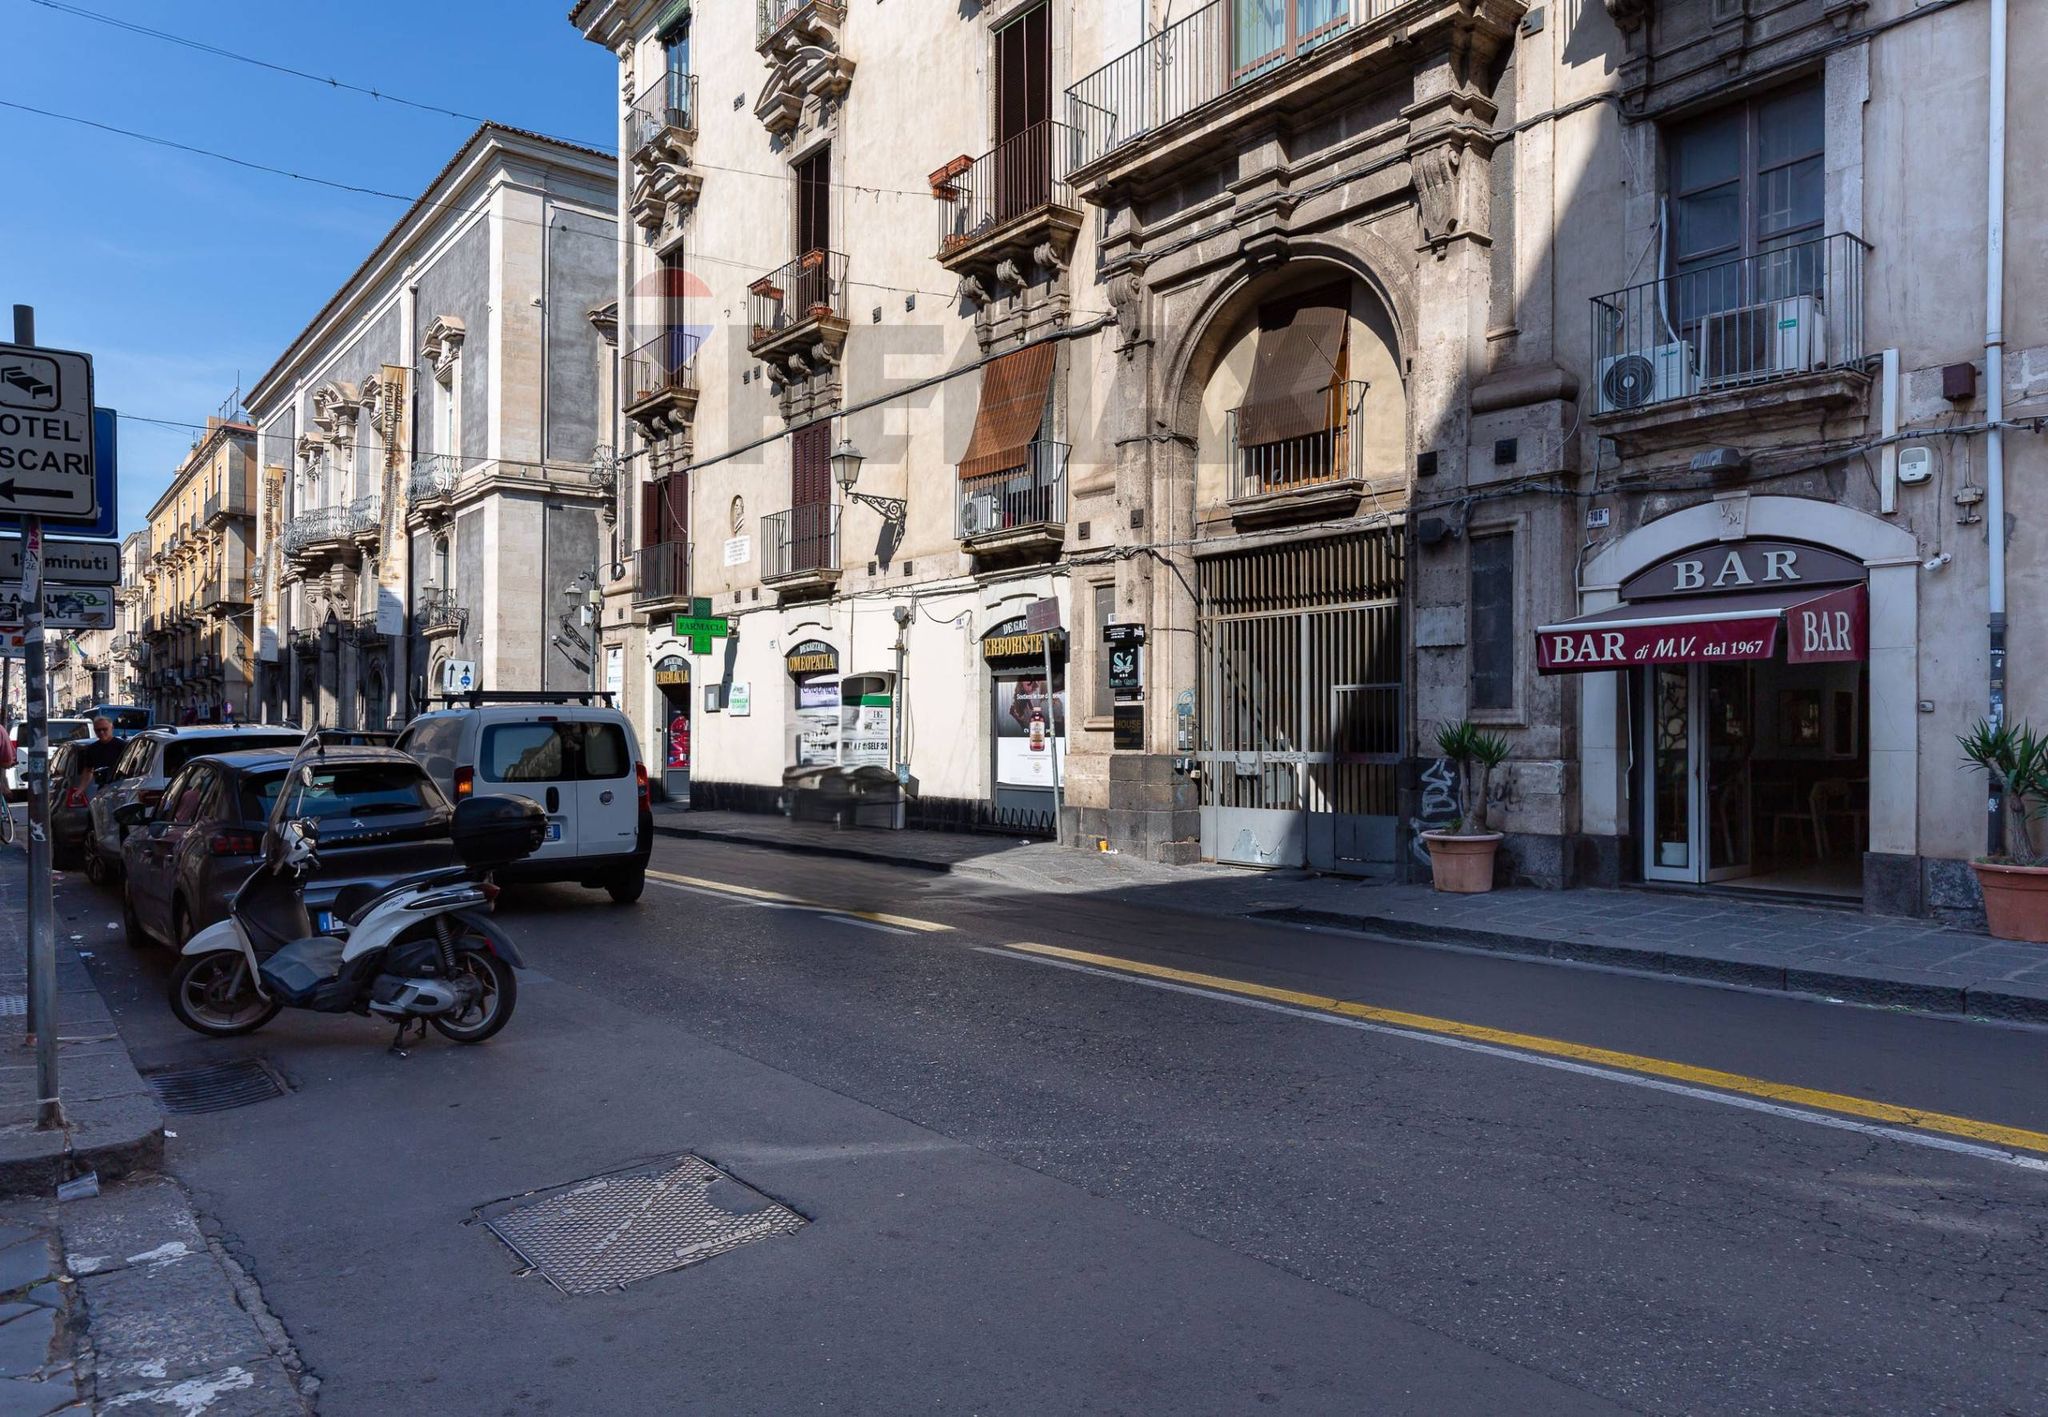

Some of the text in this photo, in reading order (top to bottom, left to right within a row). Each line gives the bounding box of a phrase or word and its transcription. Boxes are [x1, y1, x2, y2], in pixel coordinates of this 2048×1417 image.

[44, 554, 108, 570] minuti
[1672, 550, 1801, 590] BAR
[679, 622, 724, 632] FARMACIA
[1002, 620, 1028, 635] DE GAE
[1802, 611, 1851, 652] BAR
[1552, 632, 1763, 663] BAR di M.V. dal 1967
[788, 654, 834, 672] OMEOPATIA
[656, 670, 689, 685] FARMACIA
